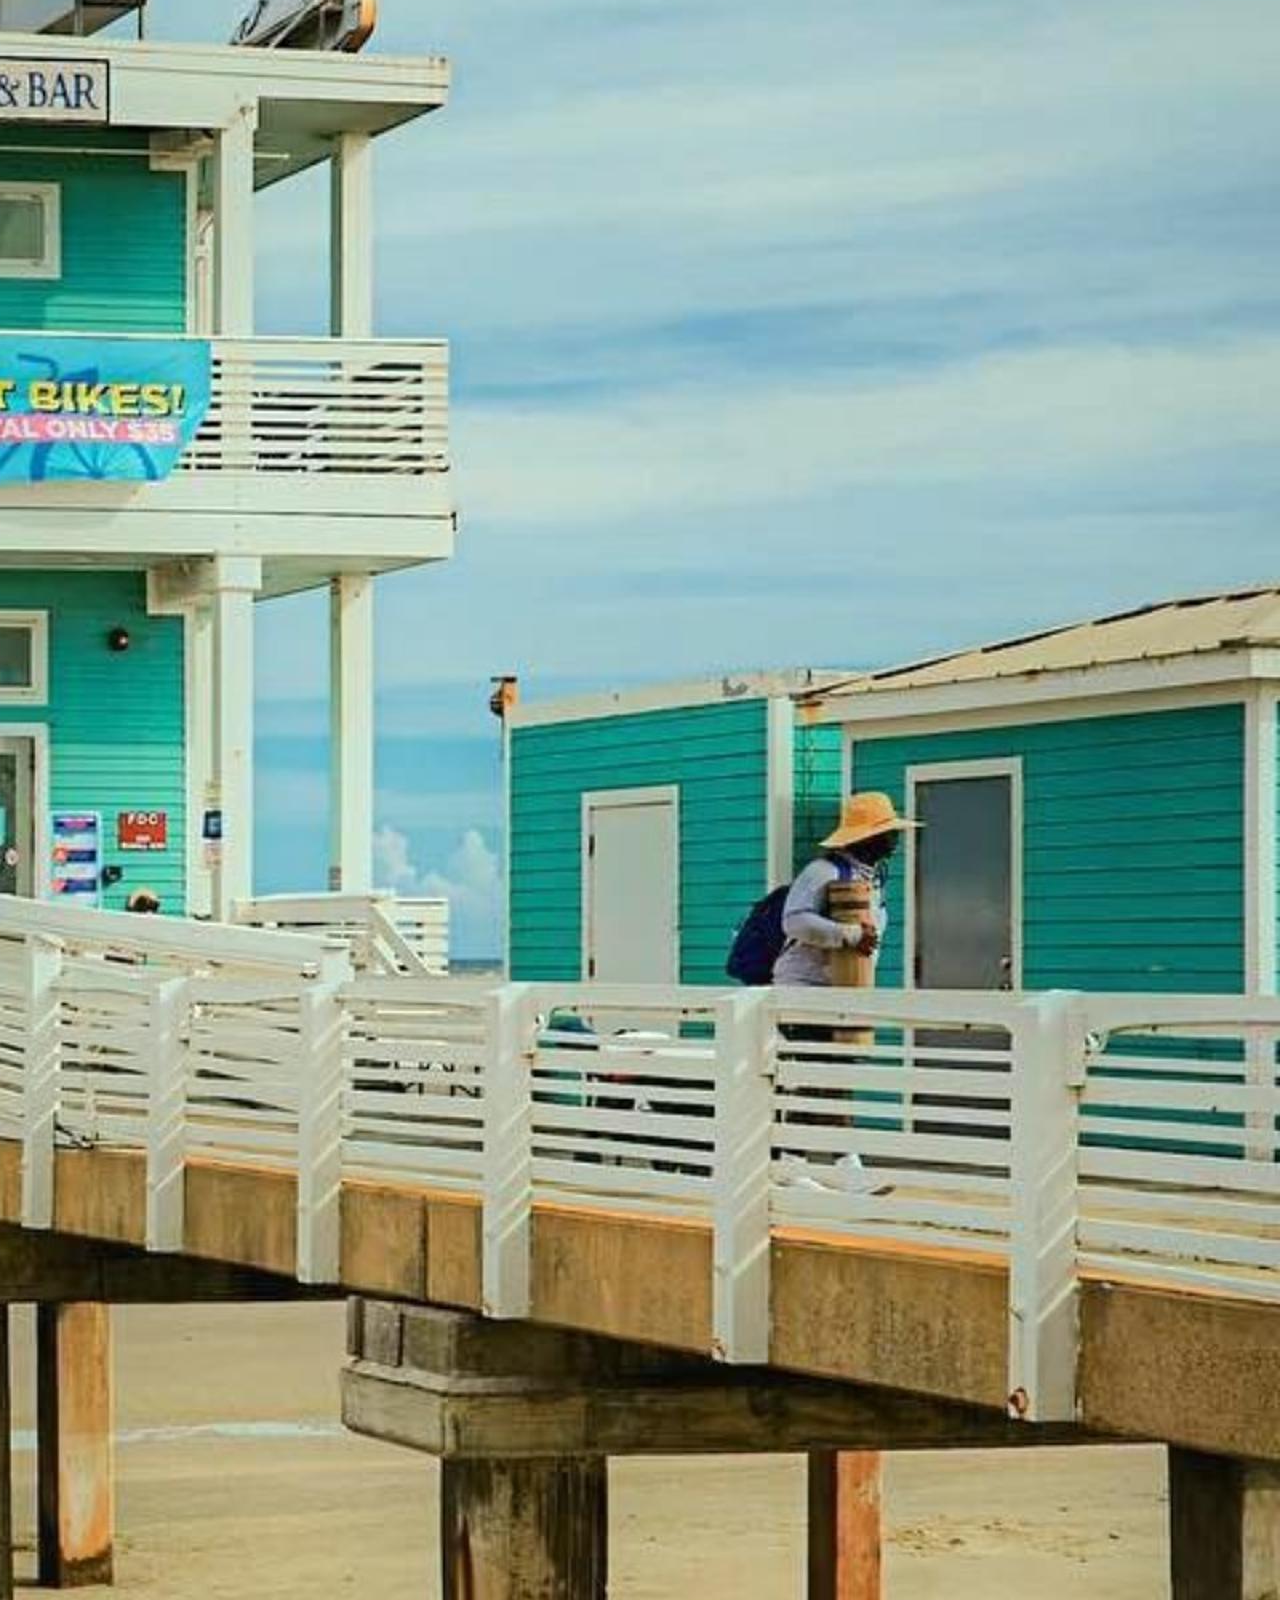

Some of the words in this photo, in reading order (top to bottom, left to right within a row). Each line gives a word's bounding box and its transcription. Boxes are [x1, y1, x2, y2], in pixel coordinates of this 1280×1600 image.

[28, 71, 100, 110] BAR
[28, 379, 186, 417] BIKES!
[47, 418, 123, 441] ONLY
